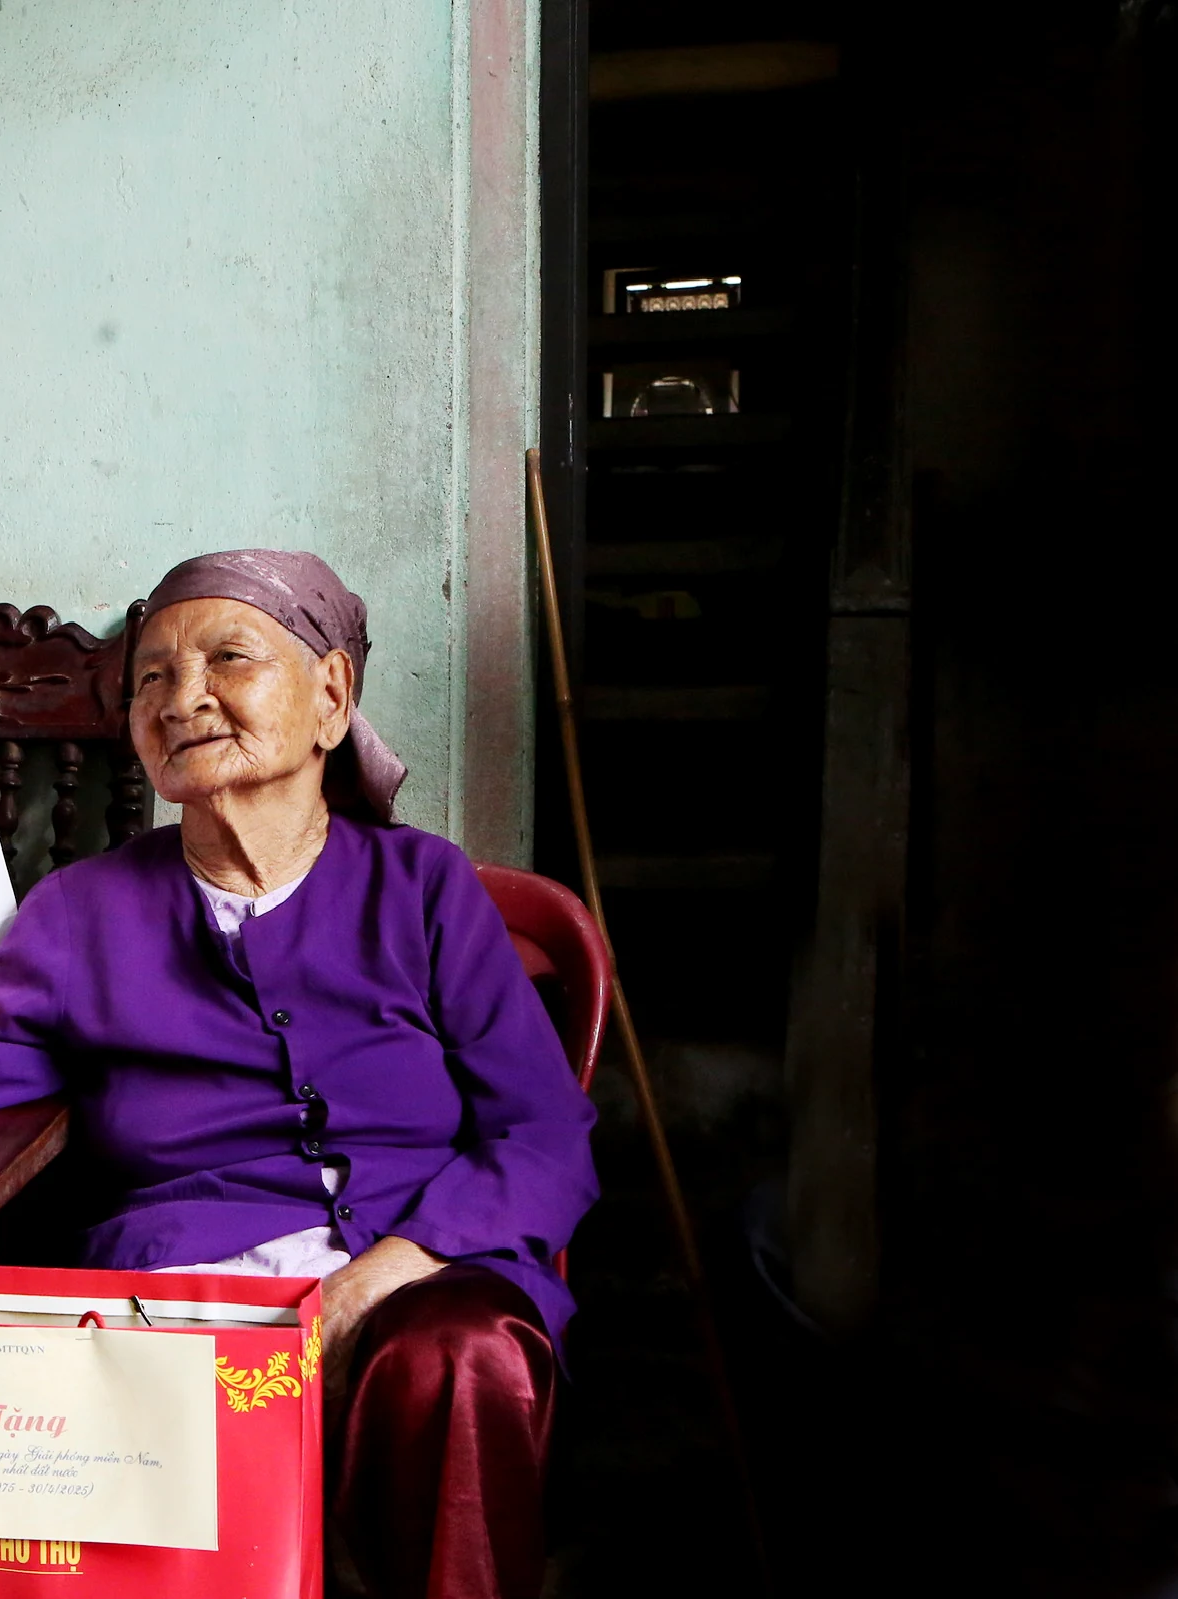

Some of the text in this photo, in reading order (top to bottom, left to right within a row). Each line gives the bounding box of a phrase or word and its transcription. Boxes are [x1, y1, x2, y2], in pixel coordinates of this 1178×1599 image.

[24, 1445, 54, 1462] Giải
[54, 1449, 90, 1466] phóng
[93, 1451, 120, 1464] miền
[124, 1451, 163, 1469] Nam,
[3, 1463, 28, 1475] nhất
[30, 1464, 50, 1476] đất
[52, 1466, 79, 1478] nước
[28, 1483, 94, 1498] 30/4/2025)
